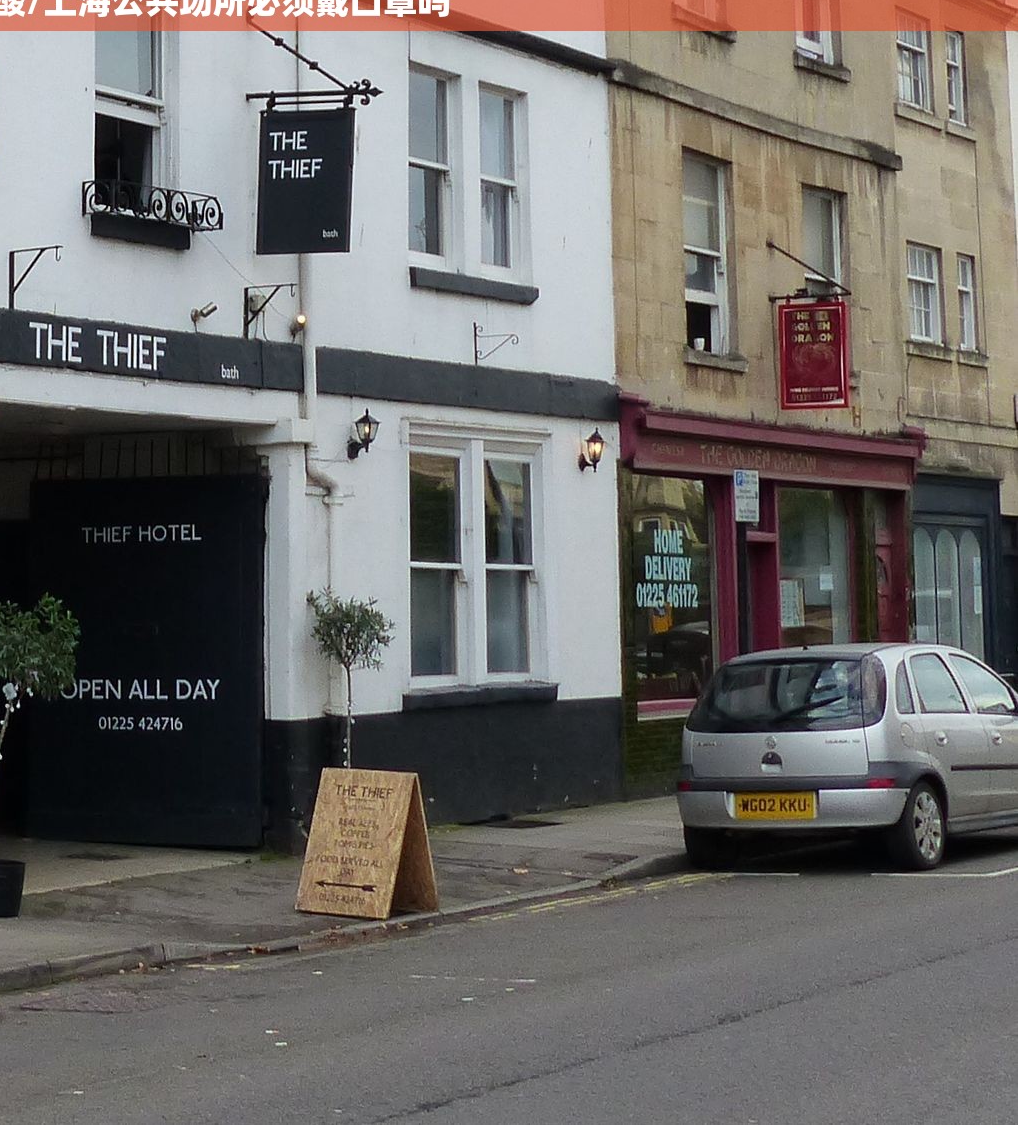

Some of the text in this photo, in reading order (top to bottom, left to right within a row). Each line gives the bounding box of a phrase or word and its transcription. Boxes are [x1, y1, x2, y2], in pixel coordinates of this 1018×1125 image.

[269, 130, 308, 151] THE
[268, 158, 323, 180] THIEF
[792, 321, 831, 331] GOLEN
[29, 321, 167, 371] THE THIEF
[792, 333, 834, 343] DRAON
[221, 364, 240, 379] bath
[81, 524, 202, 544] THIEF HOTEL
[653, 529, 684, 554] HOME
[644, 555, 692, 581] DELIVERY
[636, 583, 699, 608] 01225 461172
[128, 679, 169, 700] ALL
[175, 679, 221, 700] DAY
[98, 716, 183, 731] 01225 424716
[336, 784, 393, 799] THE THIEF
[742, 798, 807, 812] WG02 KKU
